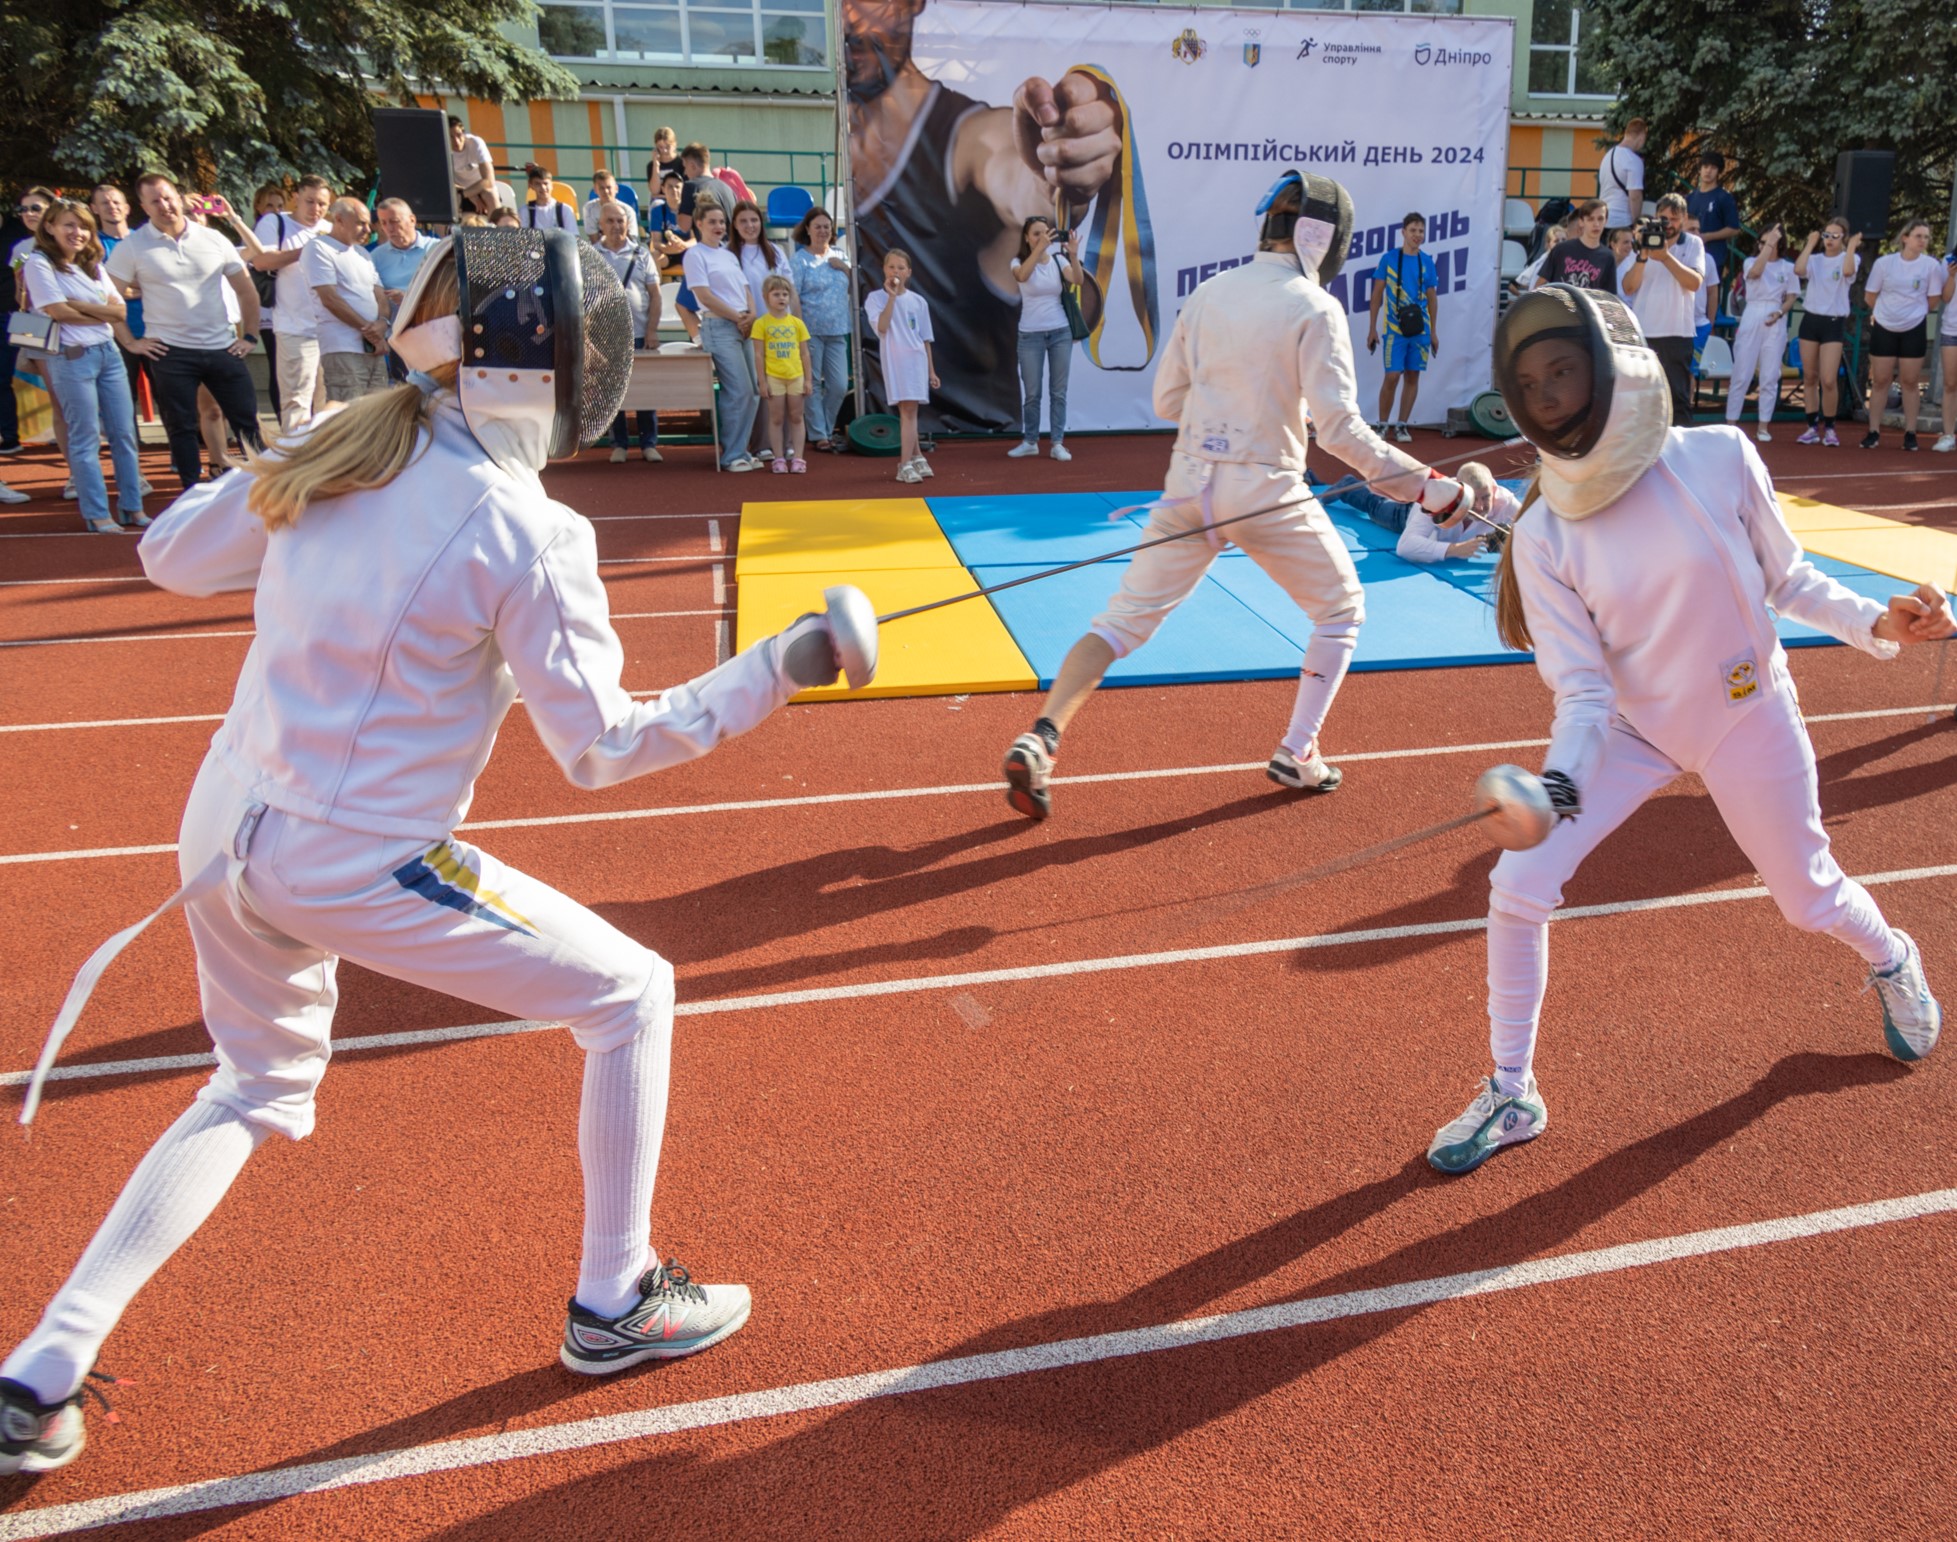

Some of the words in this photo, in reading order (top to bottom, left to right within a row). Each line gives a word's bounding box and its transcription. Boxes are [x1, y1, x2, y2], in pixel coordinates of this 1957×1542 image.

[1323, 42, 1382, 54] Управління
[1322, 55, 1358, 65] спорту
[1434, 48, 1492, 67] Дніпро
[1167, 138, 1357, 163] ОЛІМПІЙСЬКИЙ
[1363, 146, 1423, 167] ДЕНЬ
[1431, 146, 1485, 165] 2024
[776, 350, 790, 358] DAY
